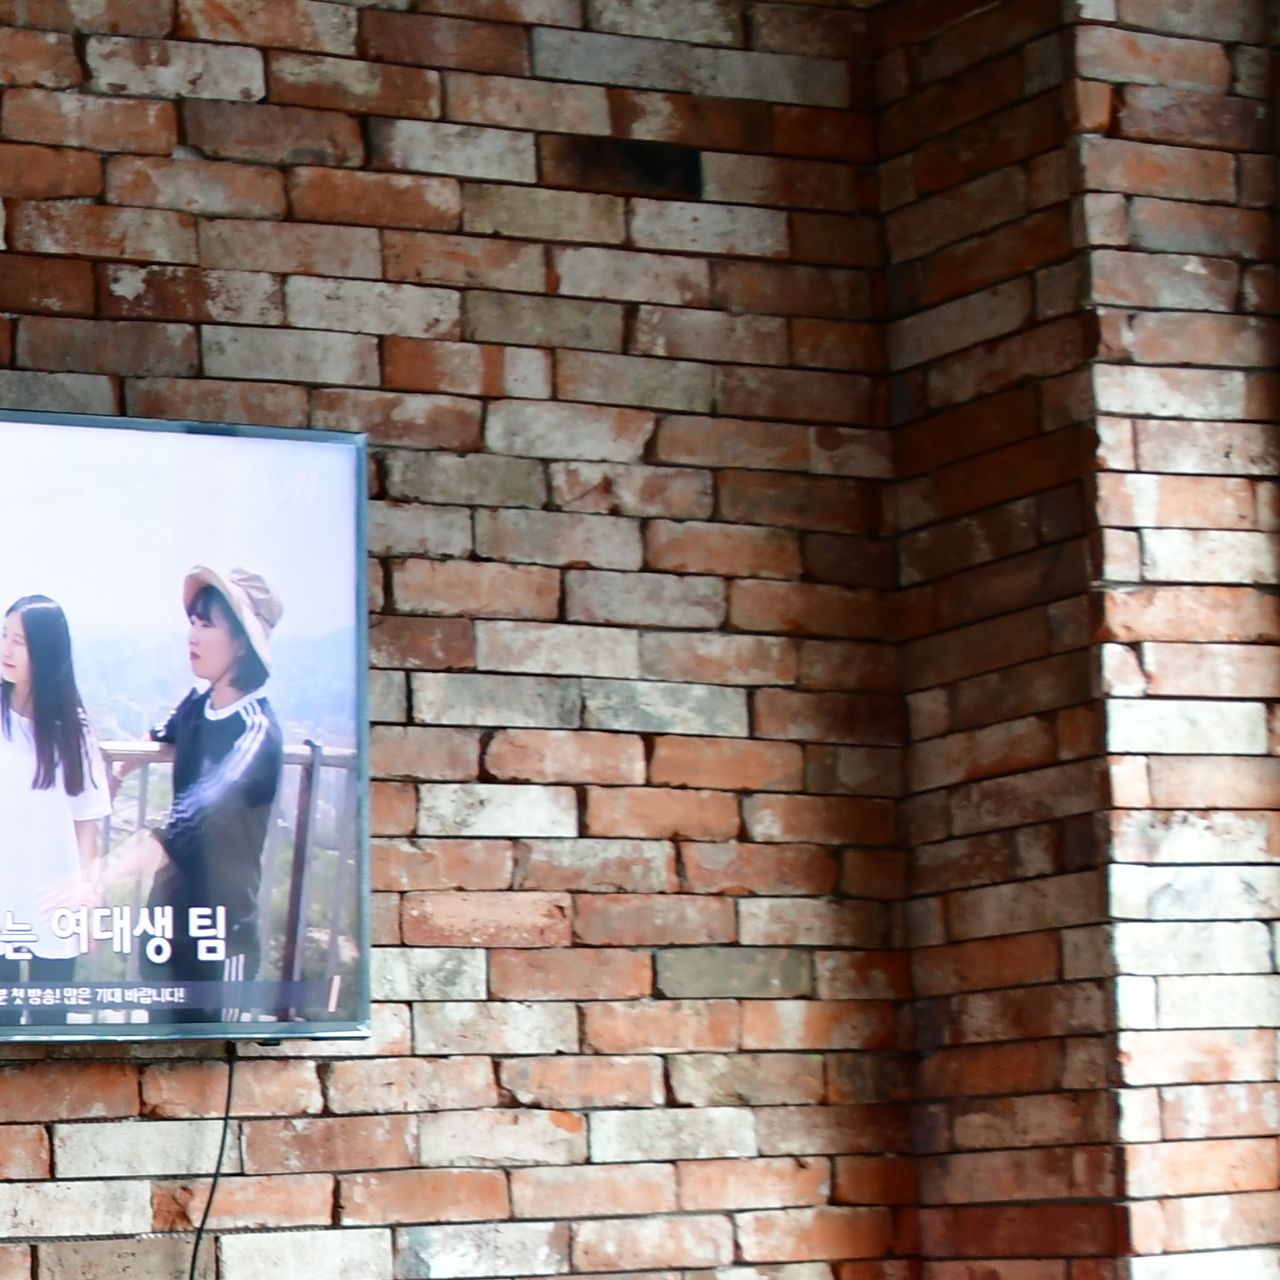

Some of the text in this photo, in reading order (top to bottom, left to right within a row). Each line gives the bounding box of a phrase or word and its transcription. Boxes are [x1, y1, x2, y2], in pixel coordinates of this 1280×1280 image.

[50, 905, 174, 964] 여대생
[188, 905, 227, 961] 팀
[63, 987, 92, 1006] 많은
[95, 987, 122, 1004] 기대
